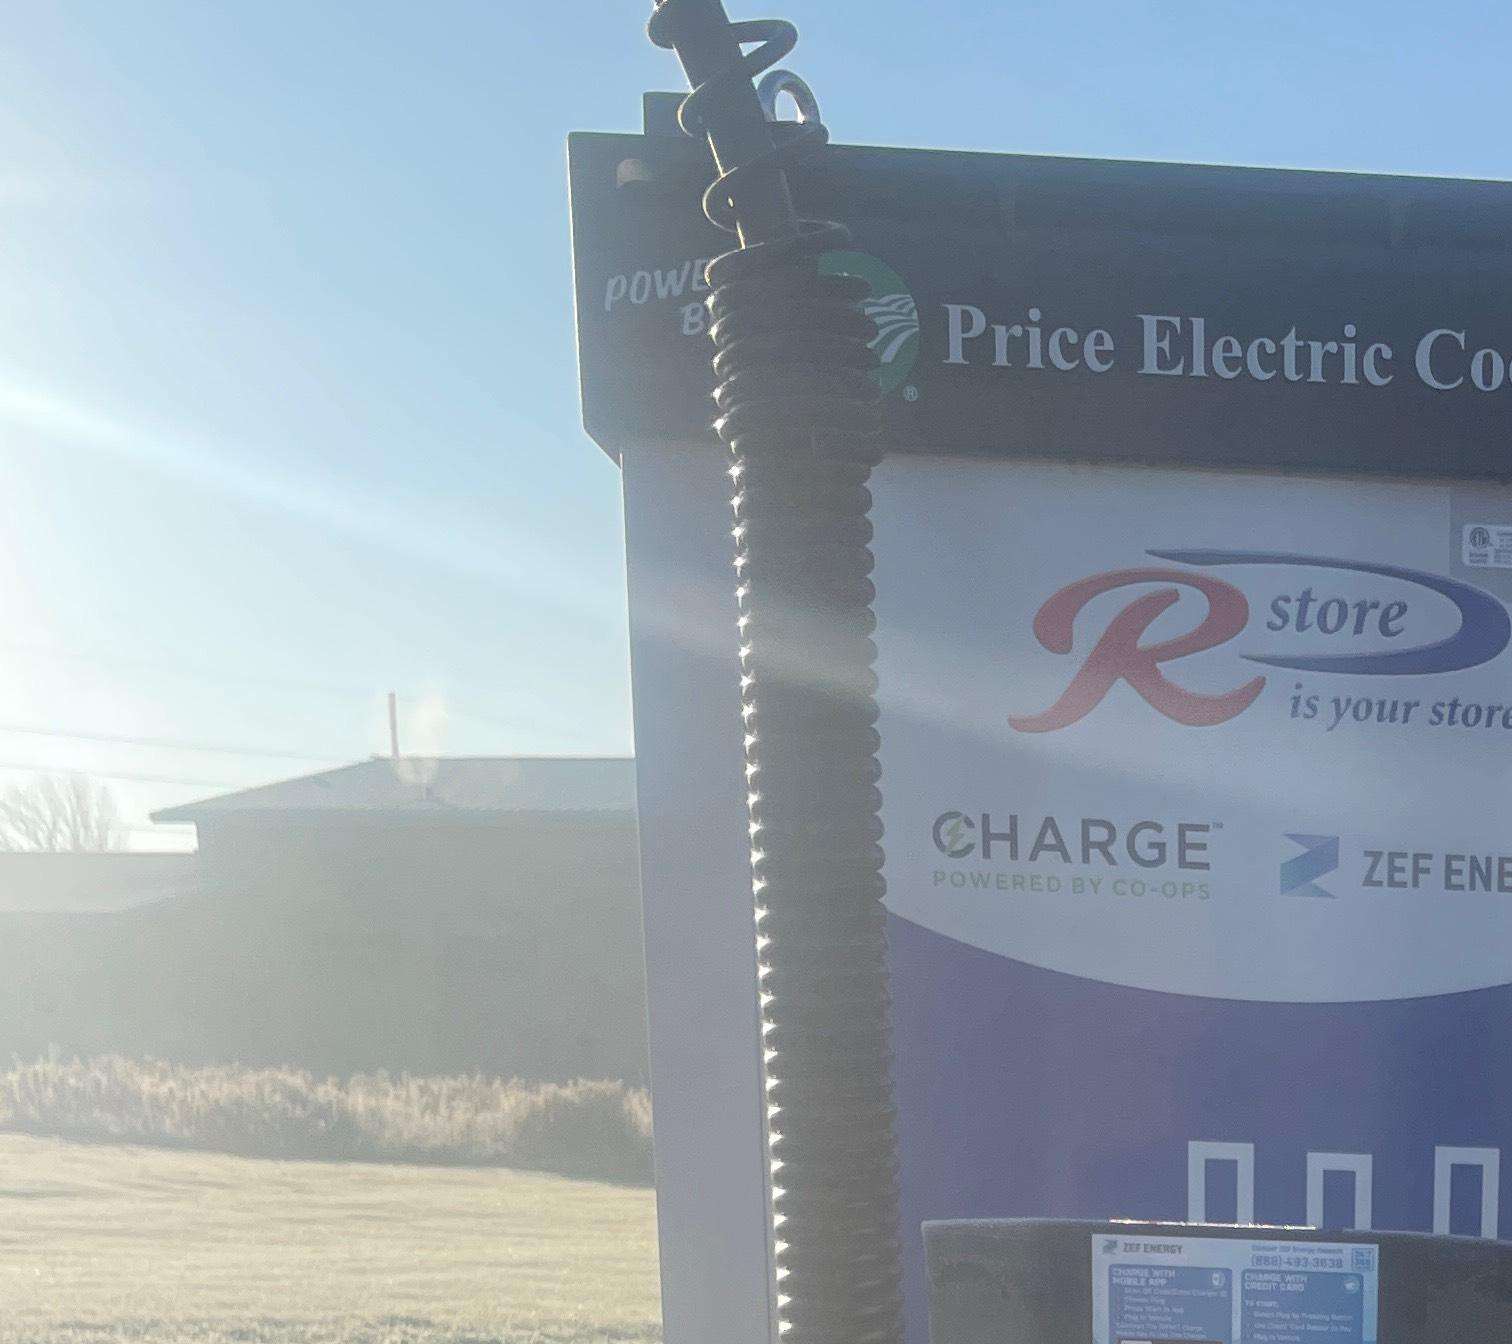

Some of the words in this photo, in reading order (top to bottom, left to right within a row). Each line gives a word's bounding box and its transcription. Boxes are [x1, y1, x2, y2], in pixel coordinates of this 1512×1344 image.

[941, 303, 1115, 373] Price
[1137, 314, 1394, 387] Electric
[1266, 587, 1409, 638] store
[1289, 683, 1318, 719] is
[1326, 694, 1420, 732] your
[932, 870, 1062, 893] POWERED
[1071, 876, 1103, 895] BY
[1112, 879, 1211, 900] CO-OPS
[1361, 849, 1434, 889] ZEF
[1122, 1242, 1141, 1253] ZEF
[1143, 1244, 1183, 1256] ENERGY
